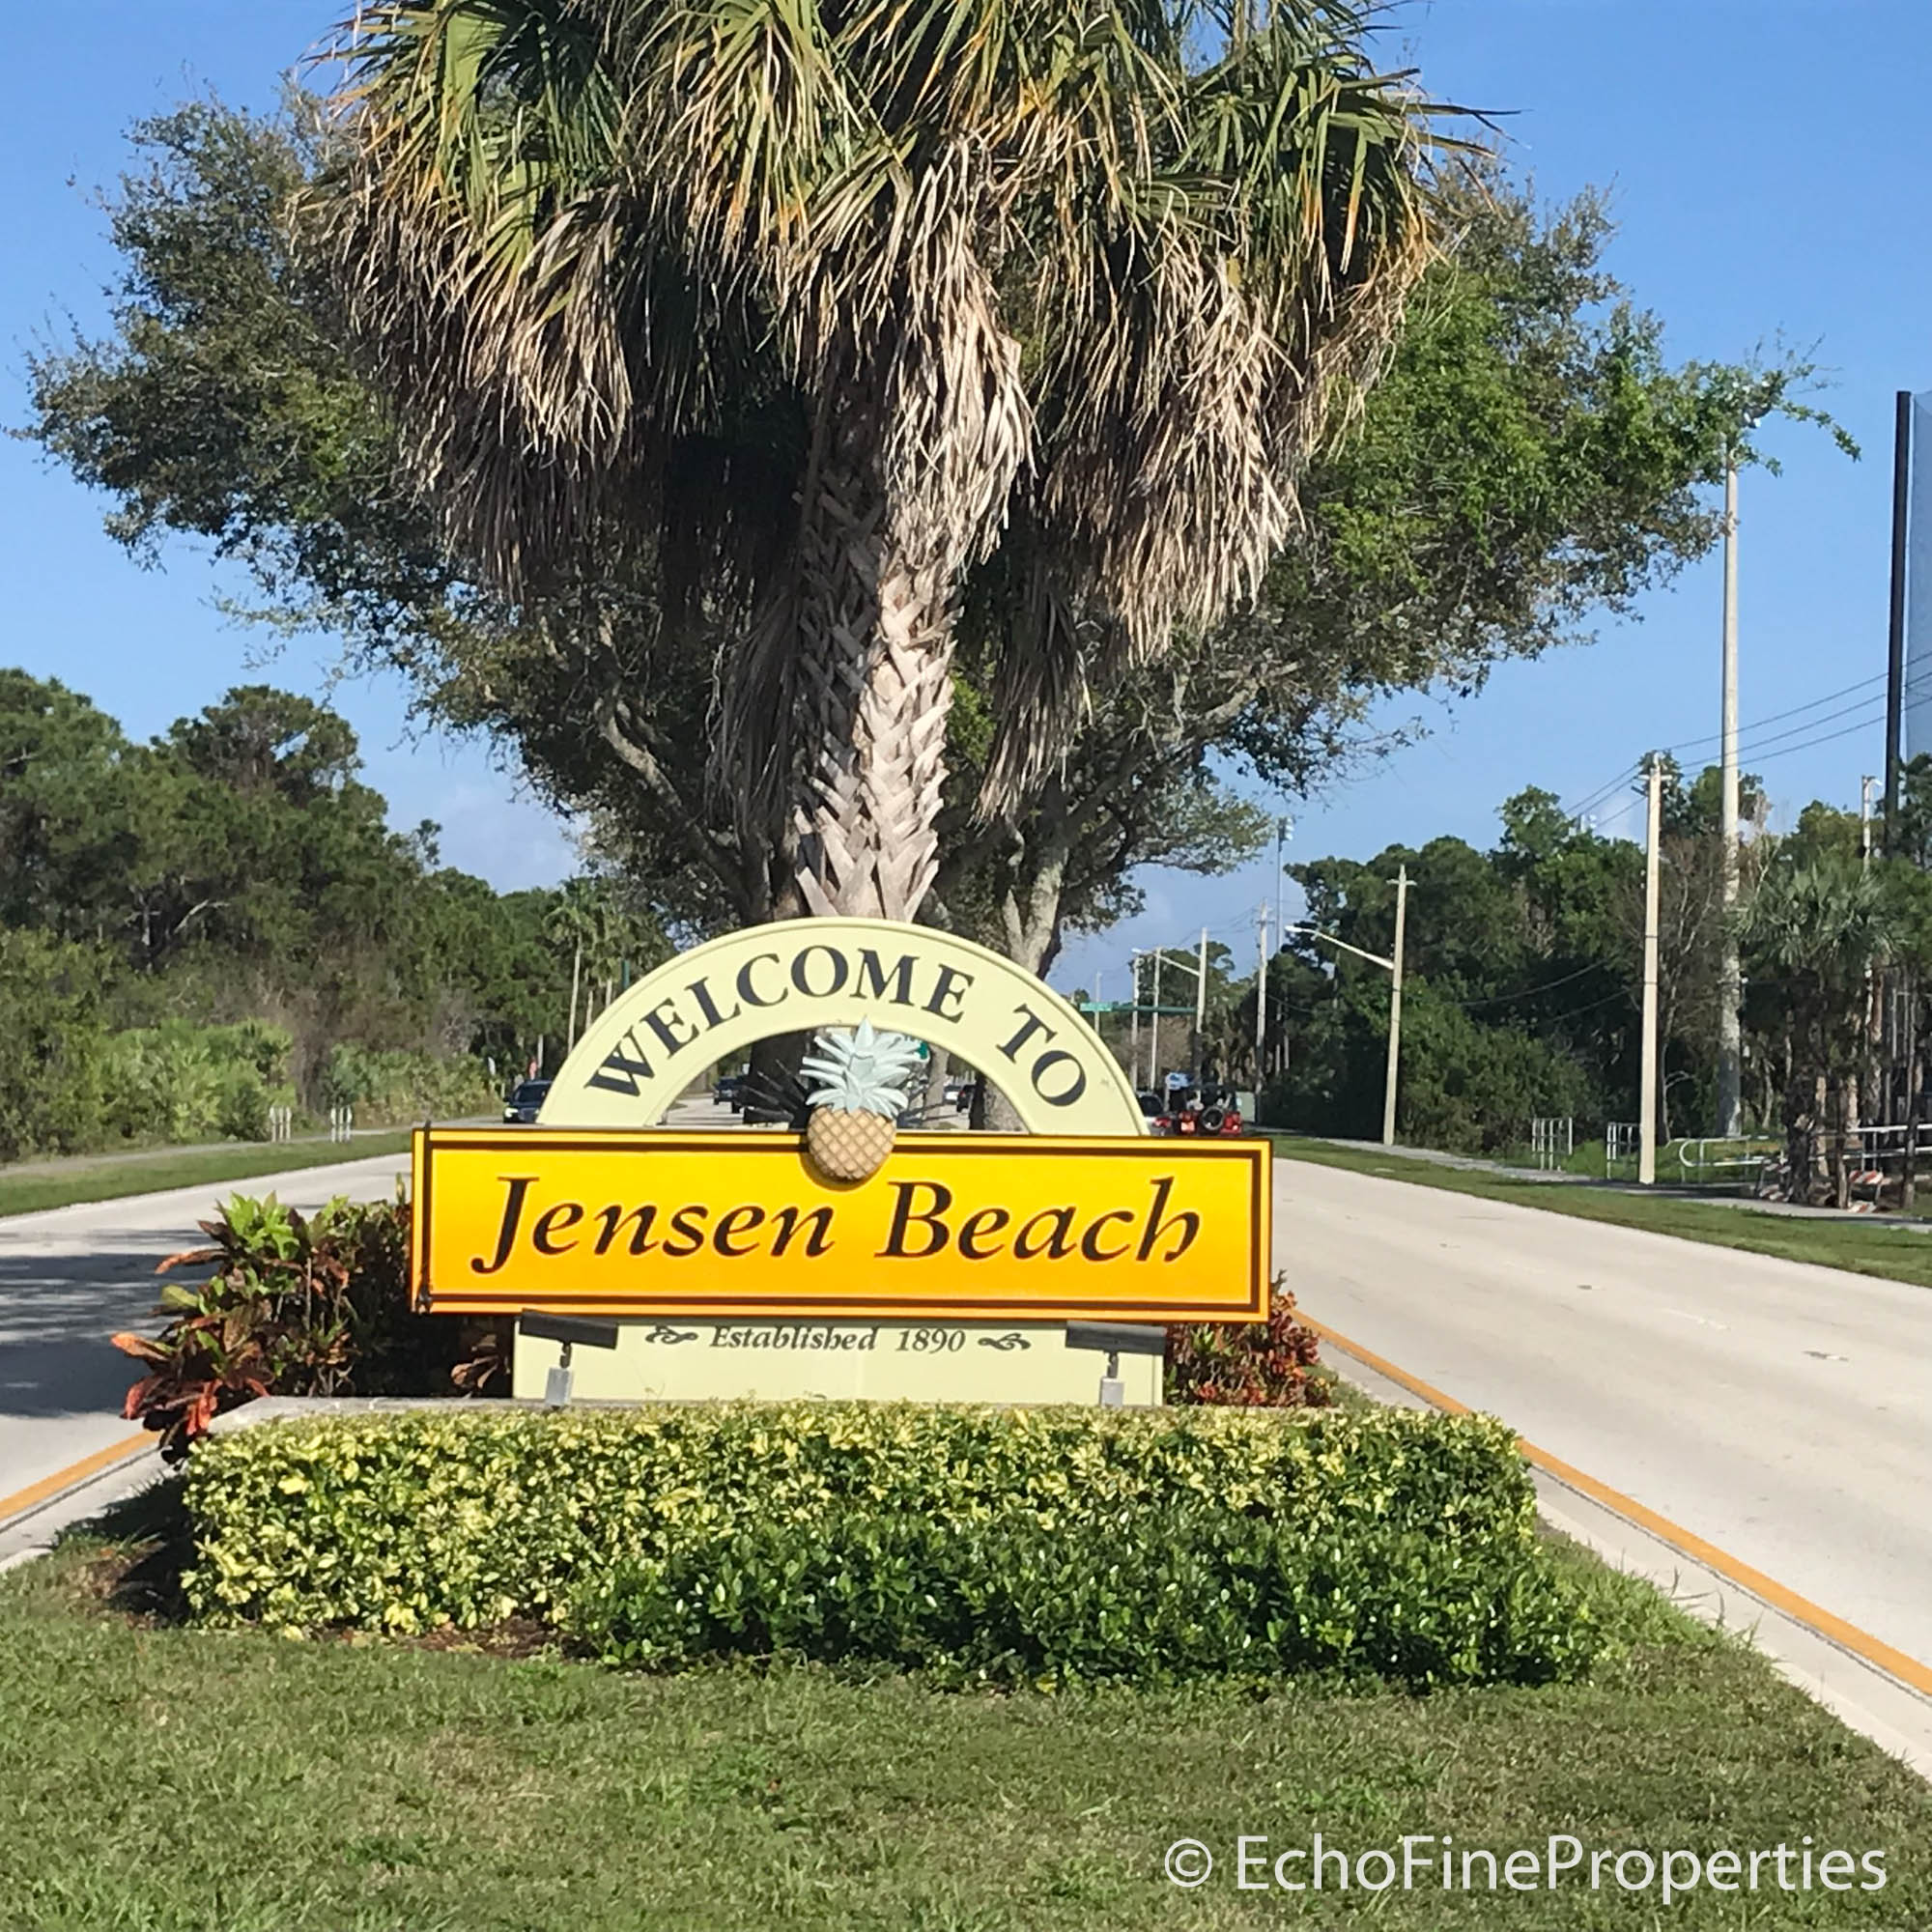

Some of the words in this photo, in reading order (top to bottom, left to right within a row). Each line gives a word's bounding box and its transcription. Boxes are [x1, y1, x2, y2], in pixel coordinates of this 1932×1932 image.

[584, 945, 975, 1097] WELCOME
[997, 1003, 1088, 1107] TO
[471, 1176, 836, 1274] Jensen
[875, 1176, 1201, 1263] Beach
[709, 1325, 880, 1350] Established
[895, 1328, 966, 1353] 1890
